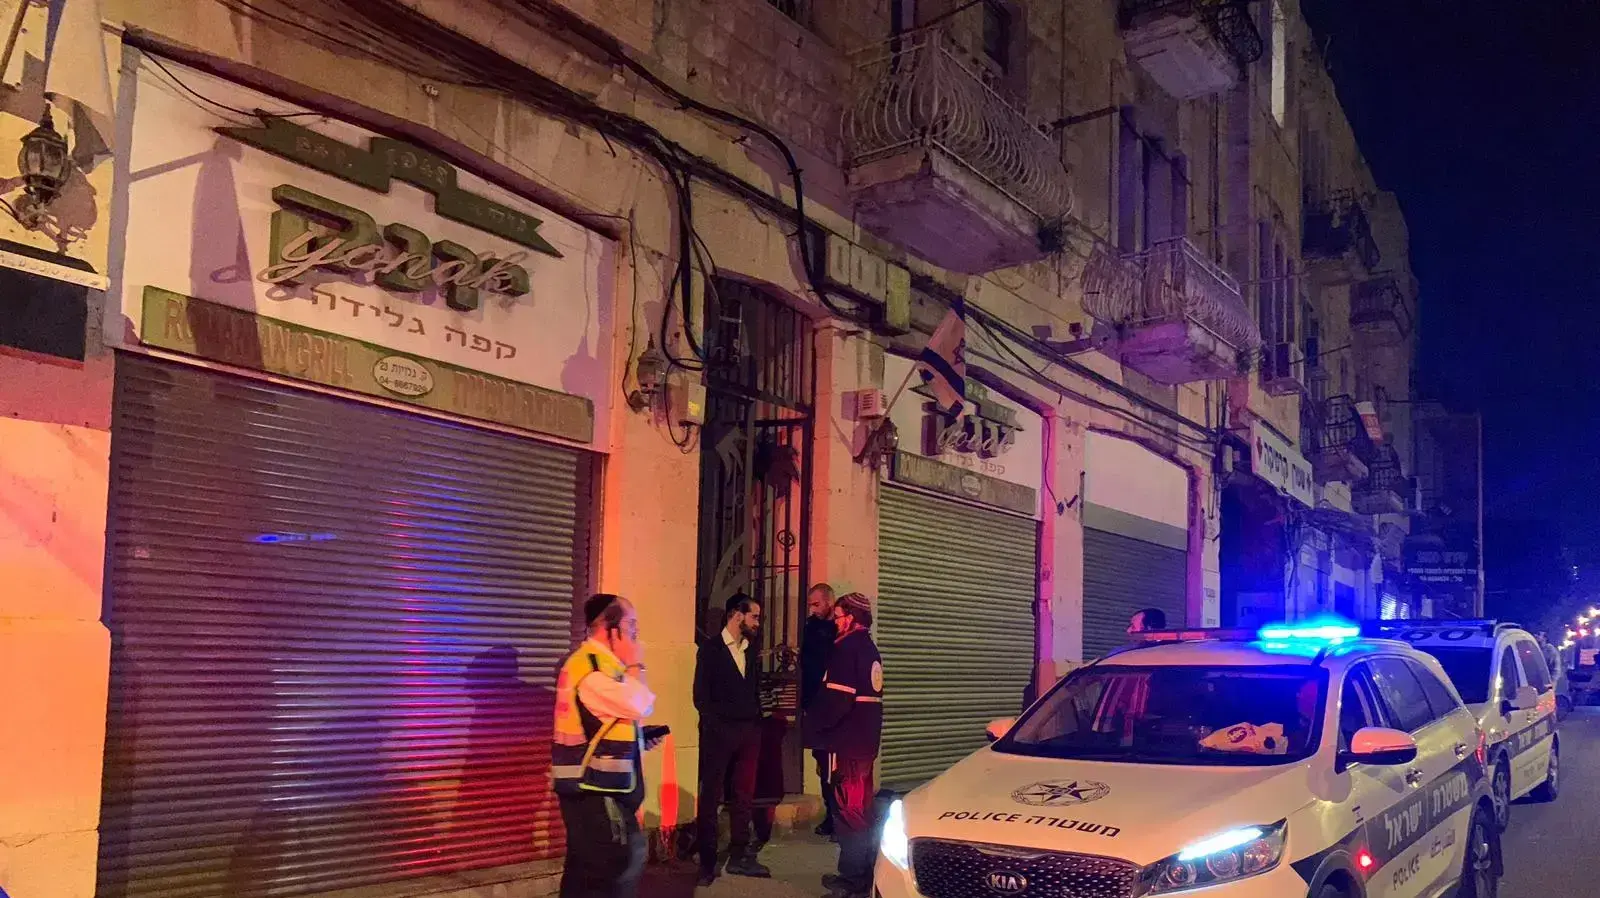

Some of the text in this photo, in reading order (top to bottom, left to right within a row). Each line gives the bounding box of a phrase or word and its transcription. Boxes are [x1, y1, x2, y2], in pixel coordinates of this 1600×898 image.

[310, 285, 517, 360] קפה גלידה
[938, 811, 1022, 823] POLICE
[1384, 772, 1468, 850] משטרת ישראל
[1025, 815, 1121, 838] משטרה
[990, 873, 1018, 890] KIA
[1392, 854, 1420, 891] POLICE
